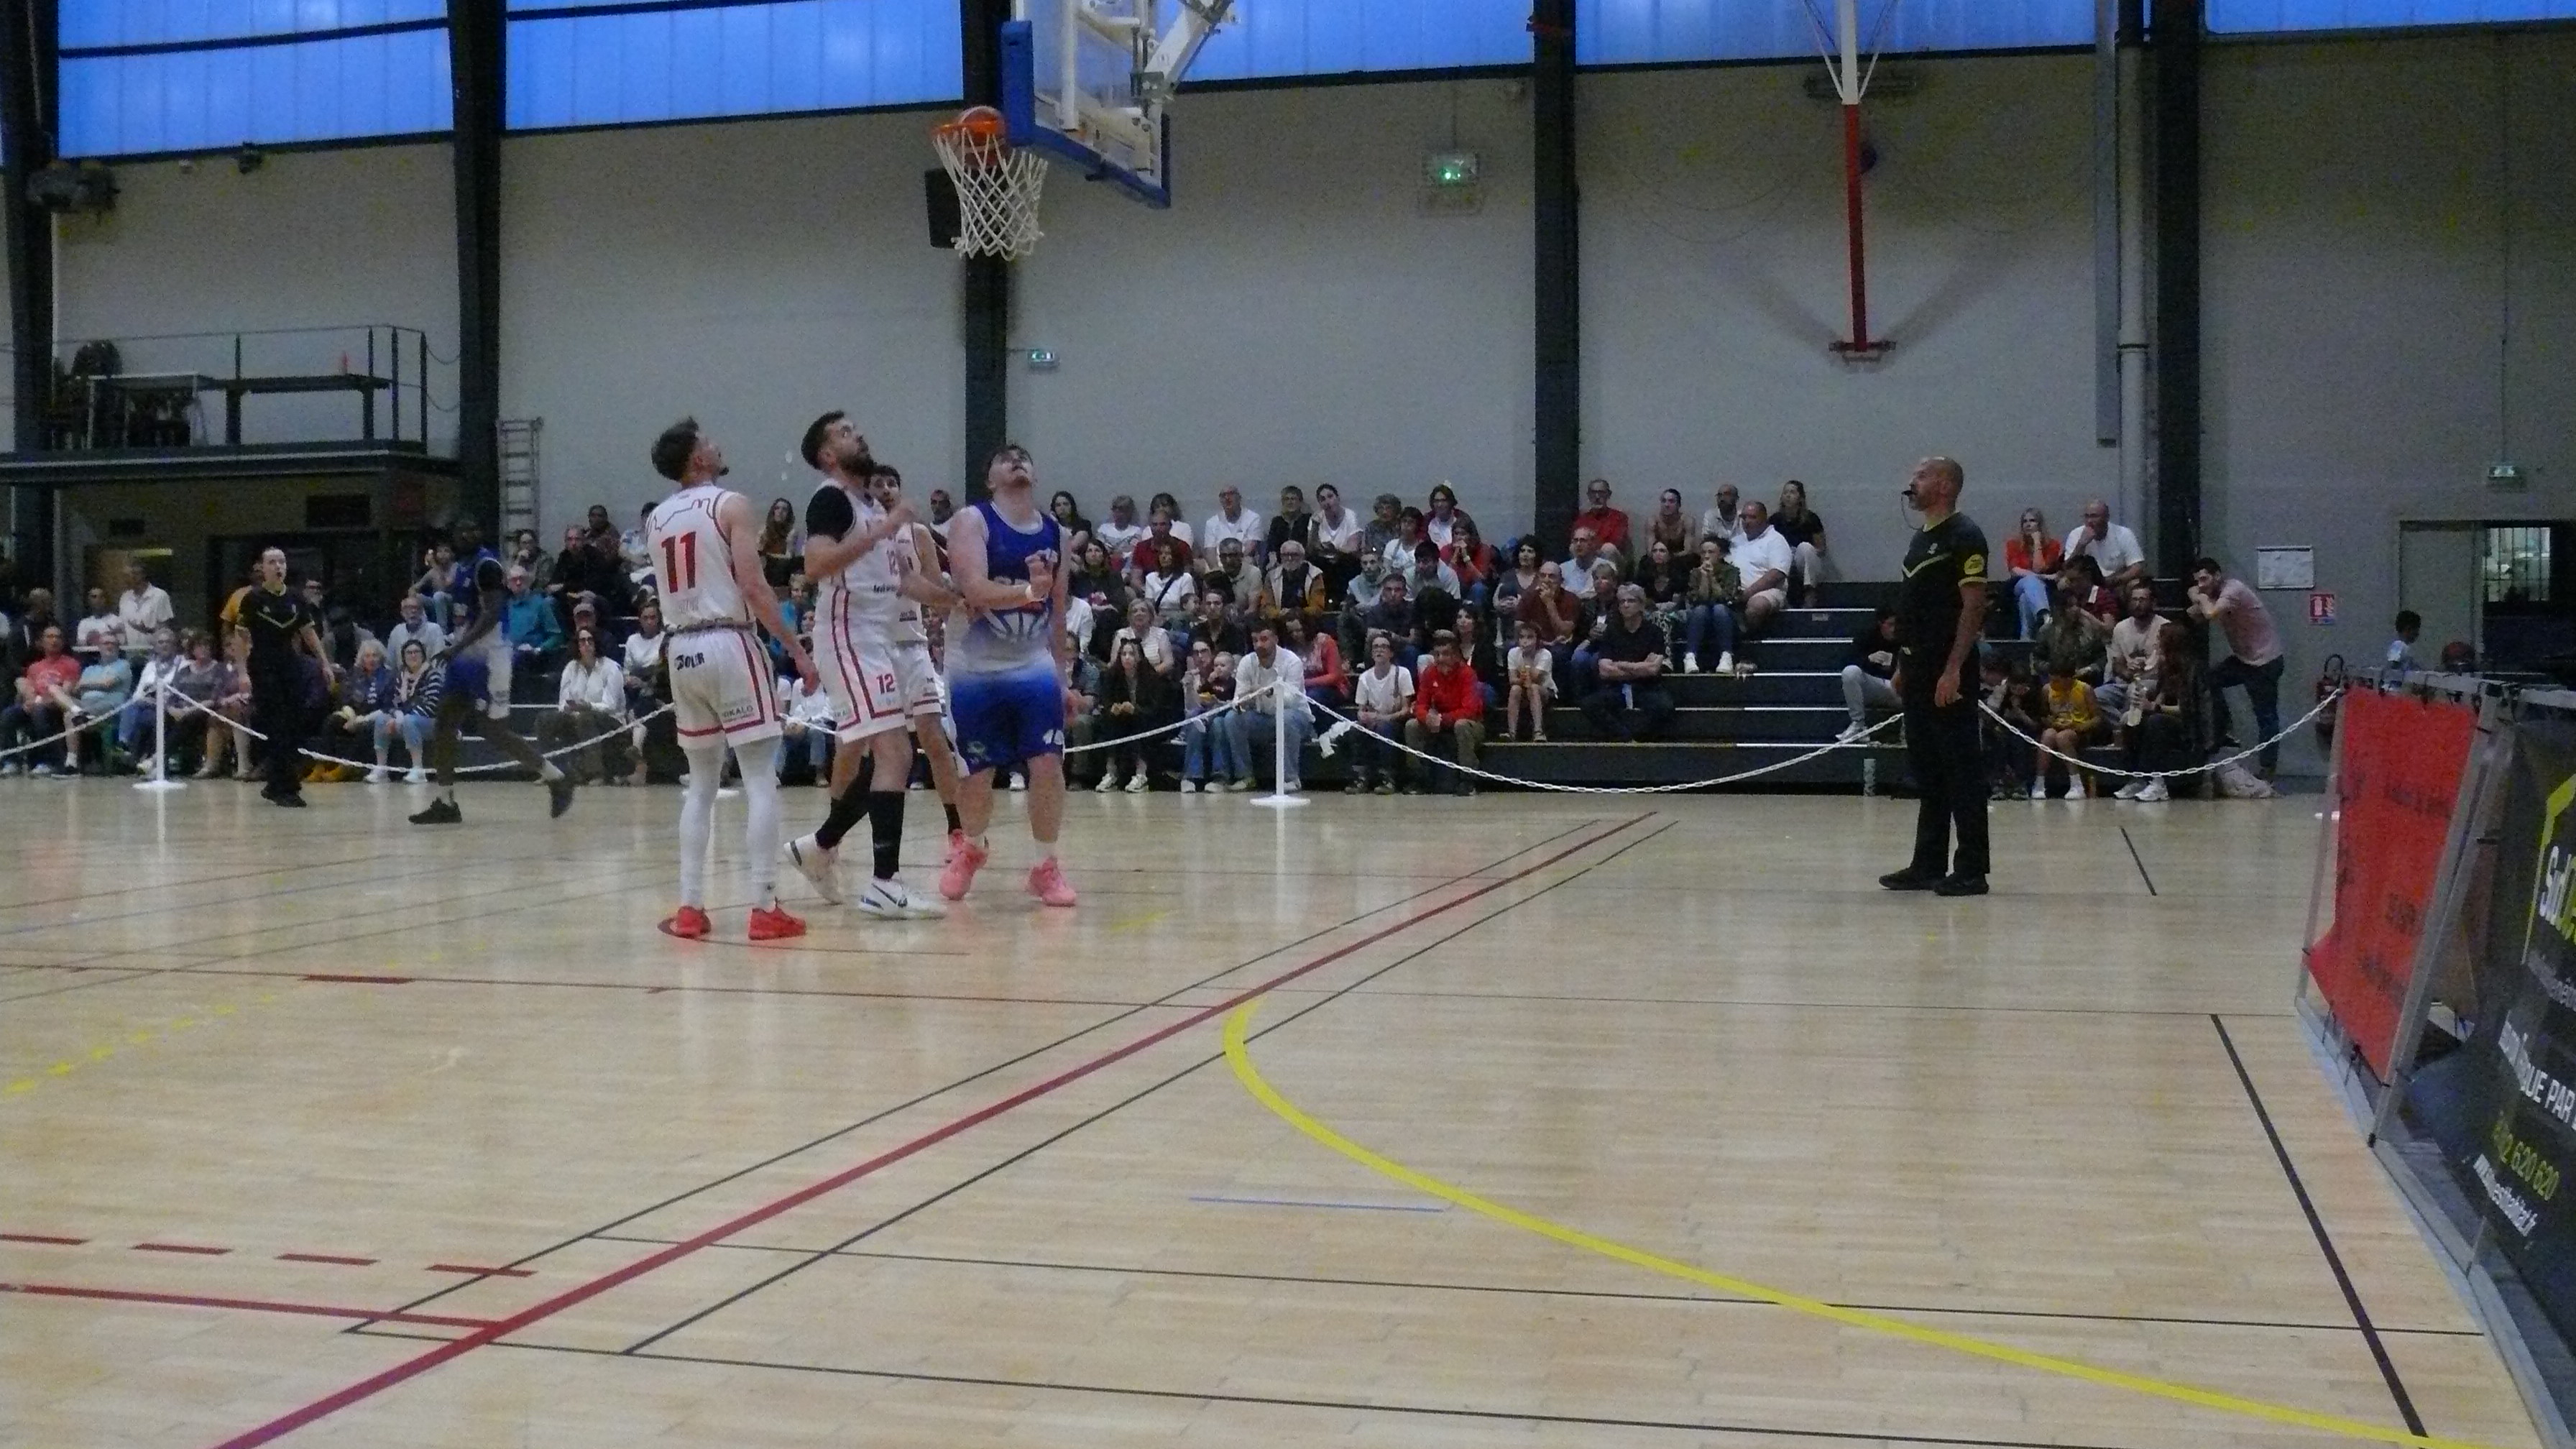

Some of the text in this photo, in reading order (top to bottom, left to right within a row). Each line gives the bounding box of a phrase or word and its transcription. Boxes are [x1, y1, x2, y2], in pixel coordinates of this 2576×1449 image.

[661, 531, 696, 594] 11
[876, 673, 896, 694] 12
[2544, 1080, 2576, 1123] PAR
[2511, 1141, 2559, 1201] 620 620
